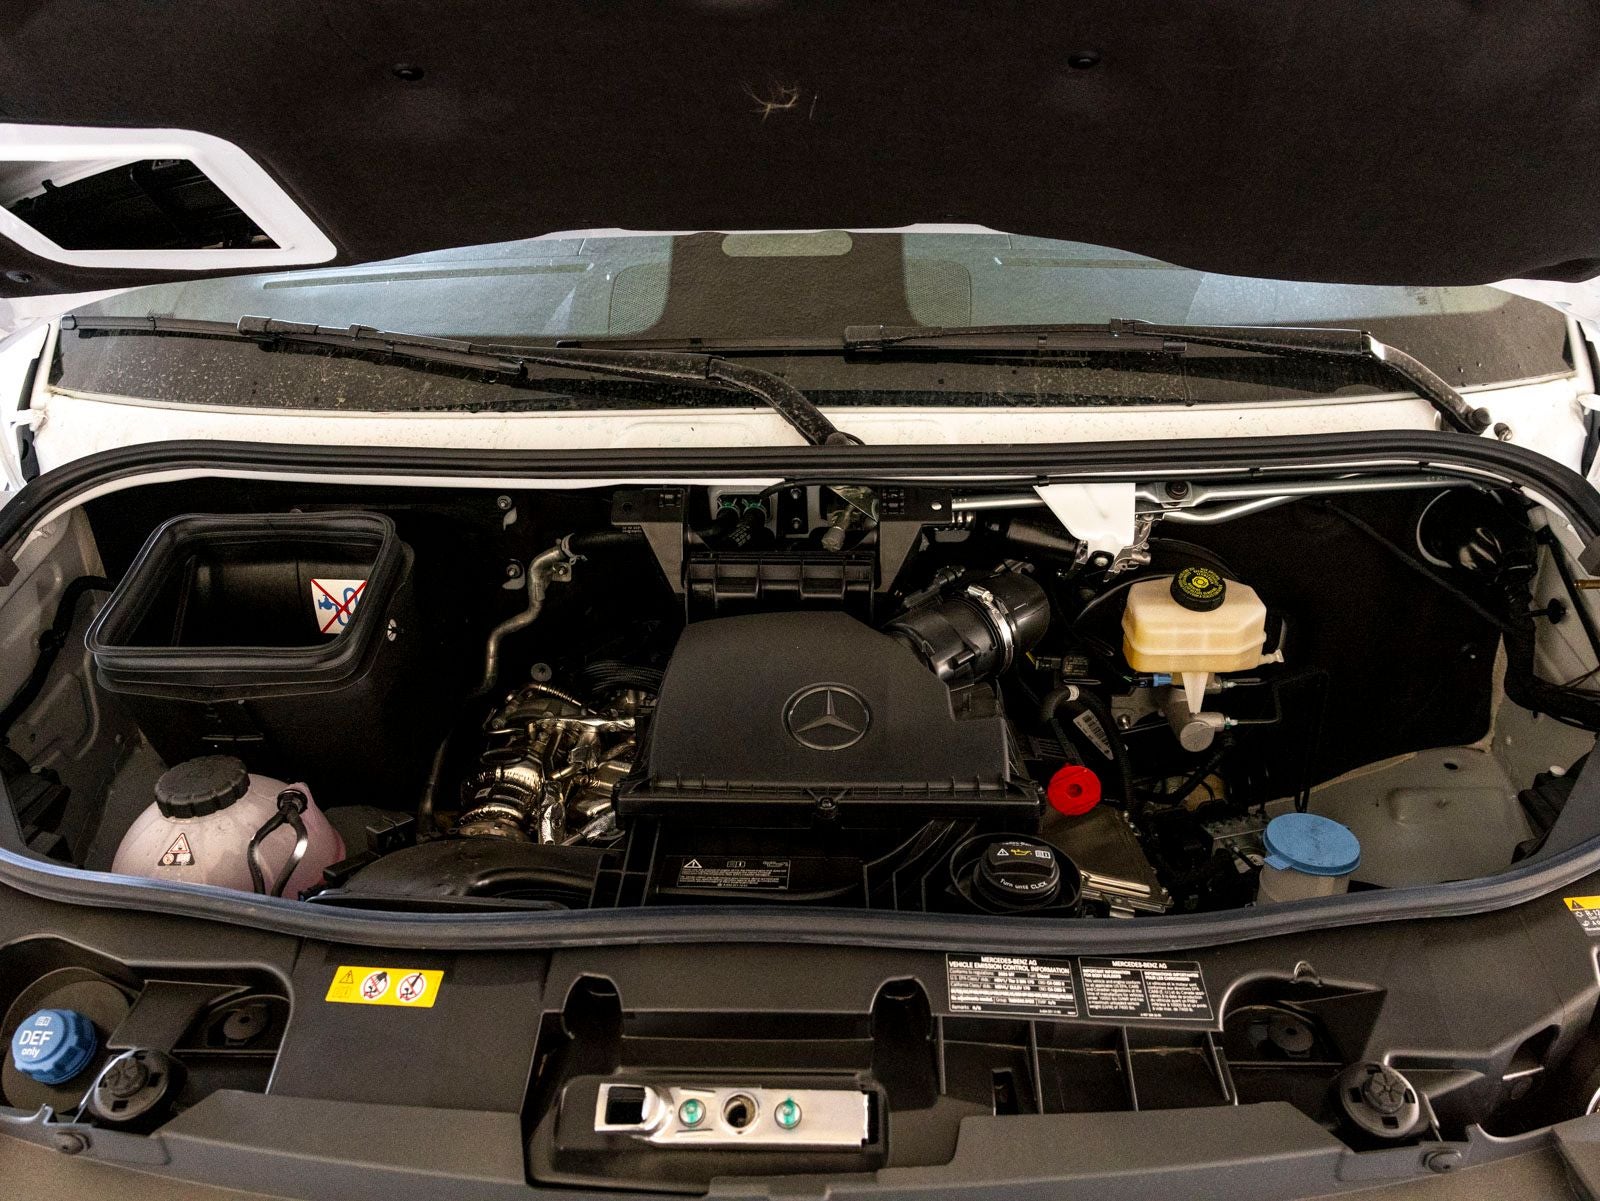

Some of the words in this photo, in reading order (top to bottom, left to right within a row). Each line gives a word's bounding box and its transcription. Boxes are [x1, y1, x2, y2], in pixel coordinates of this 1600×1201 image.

[1030, 881, 1048, 889] CLICK
[981, 956, 1027, 965] MERCEDES-BENZ
[18, 1030, 54, 1045] DEF
[21, 1047, 40, 1058] only
